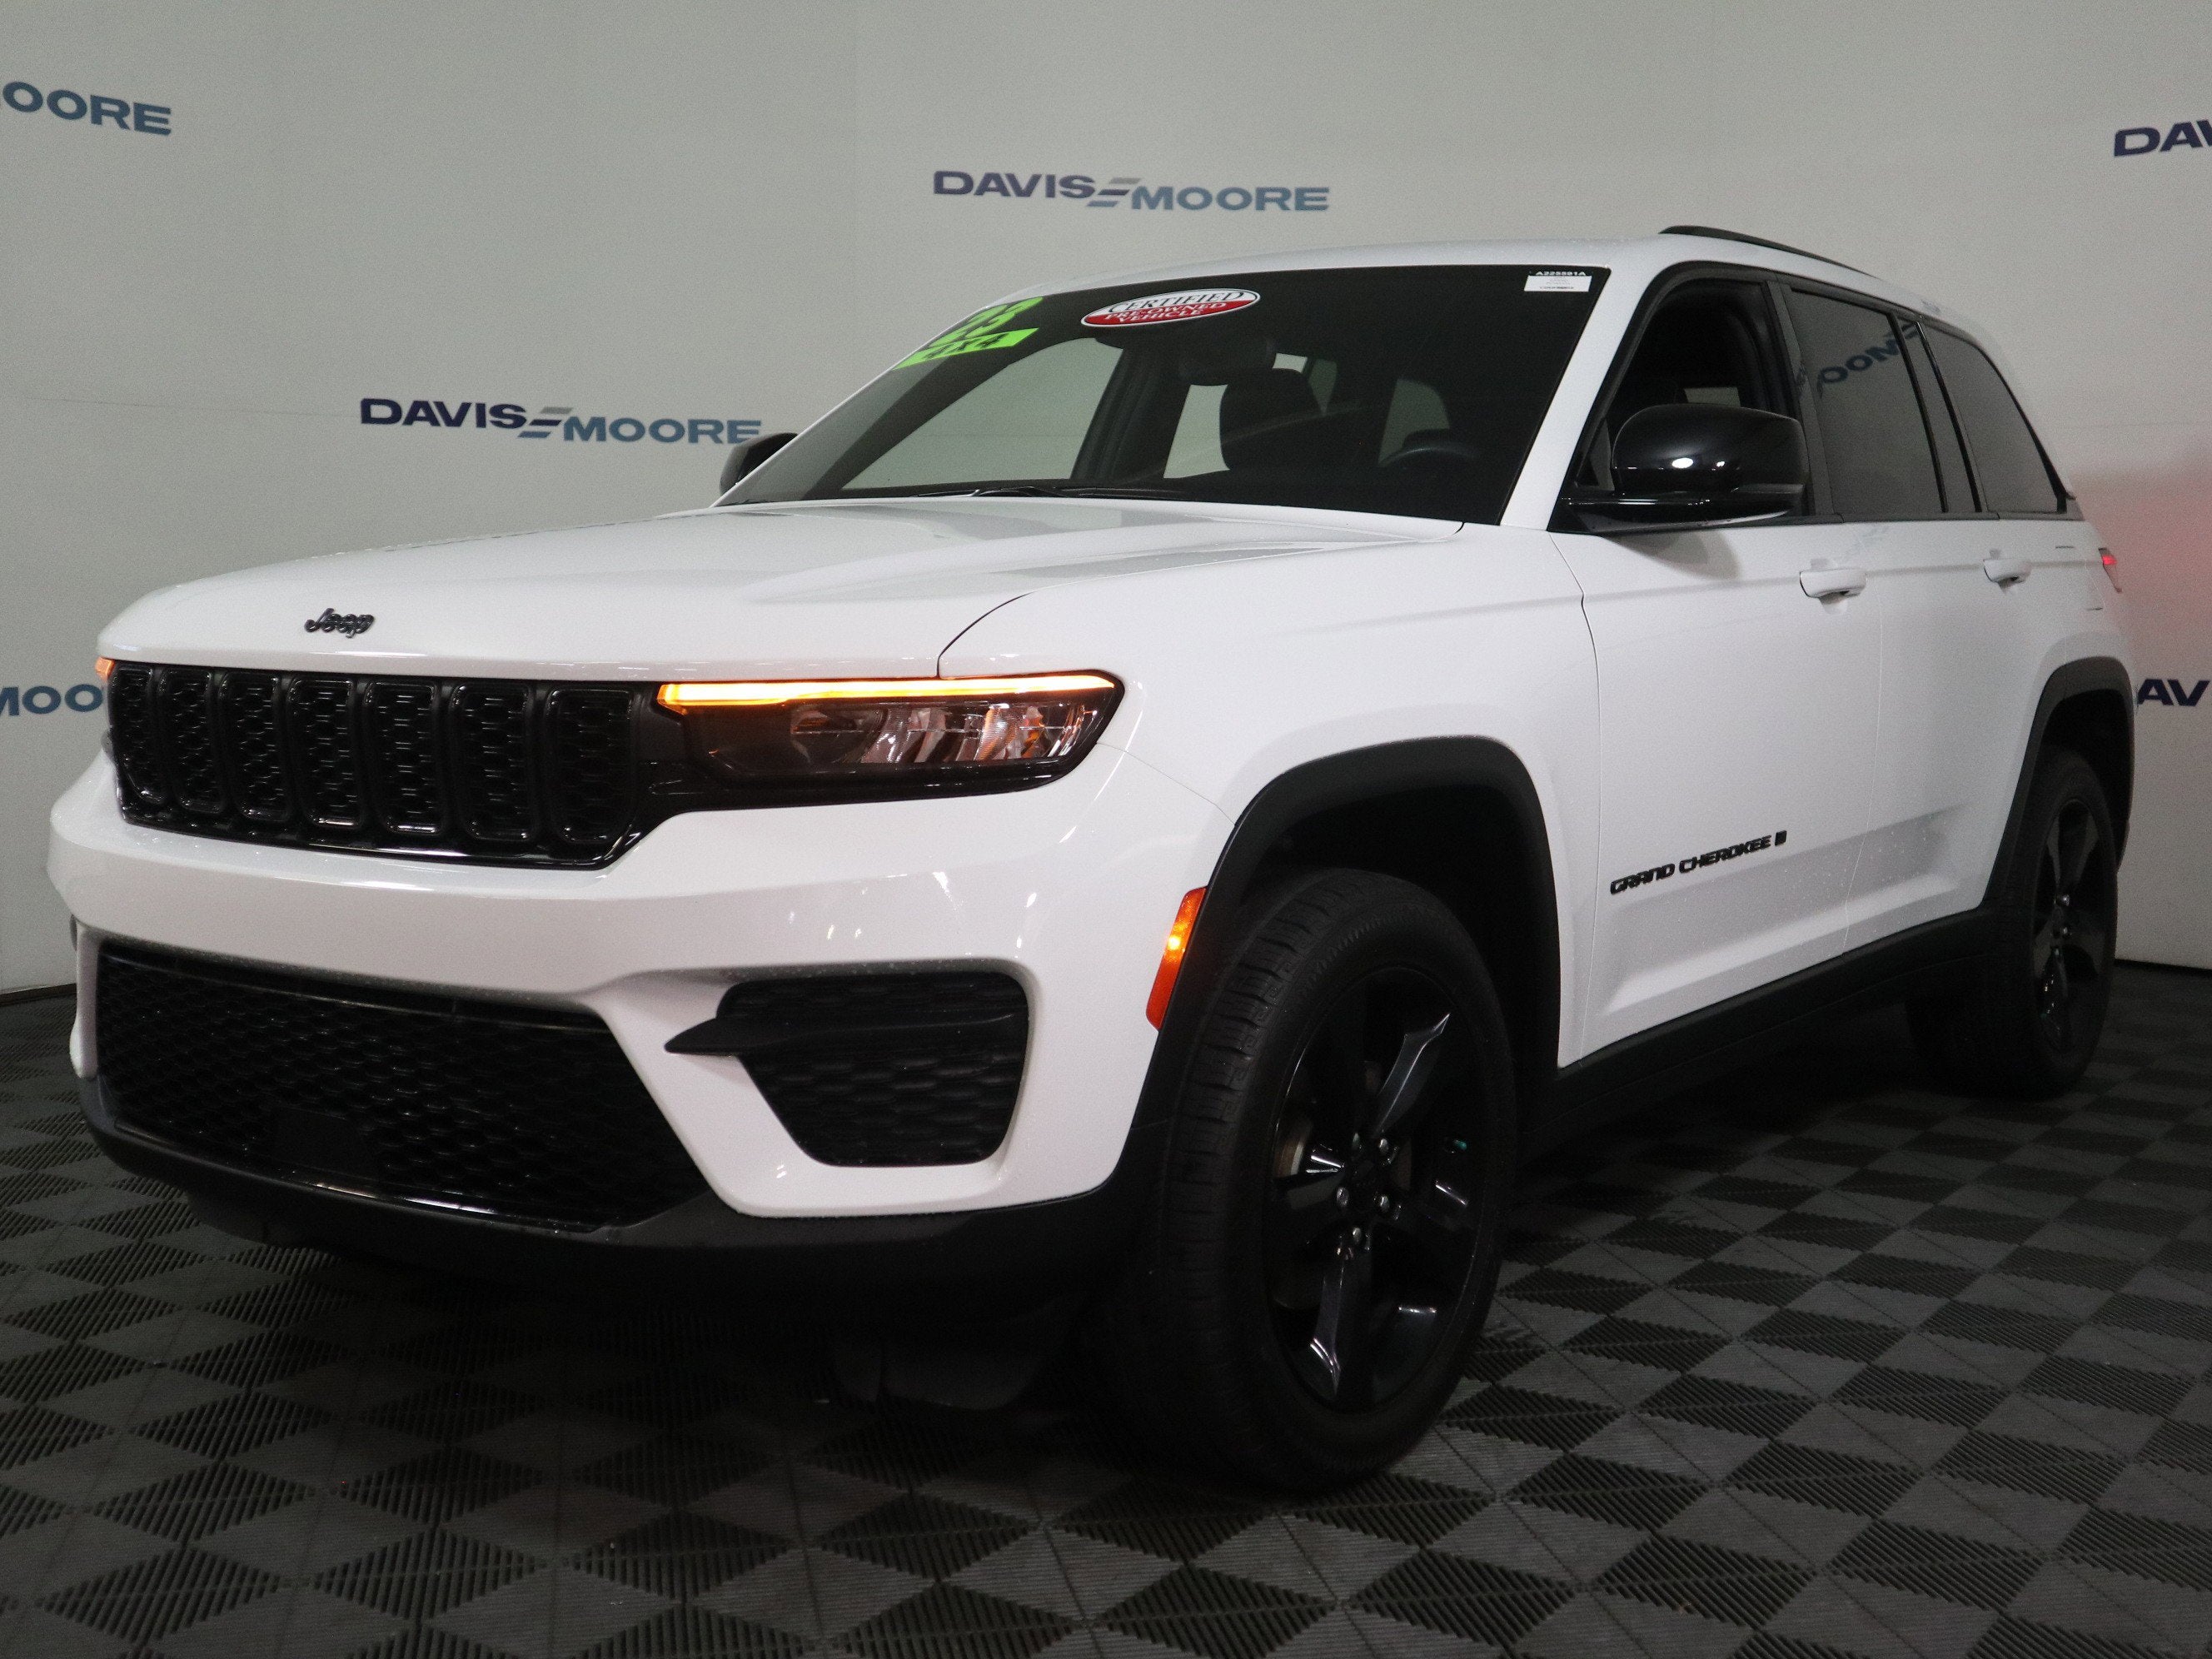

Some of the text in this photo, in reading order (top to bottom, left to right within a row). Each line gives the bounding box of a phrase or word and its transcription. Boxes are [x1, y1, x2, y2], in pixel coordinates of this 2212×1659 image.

[933, 171, 1330, 212] DAVIS MOORE
[1104, 302, 1228, 321] PRE-OWNED
[1108, 291, 1245, 313] CERTIFIED
[1118, 309, 1204, 322] VEHICLE
[360, 398, 762, 444] DAVIS MOORE
[304, 607, 375, 639] Jeep
[2136, 678, 2210, 707] AV
[1610, 834, 1772, 894] GRAND CHEROKEE
